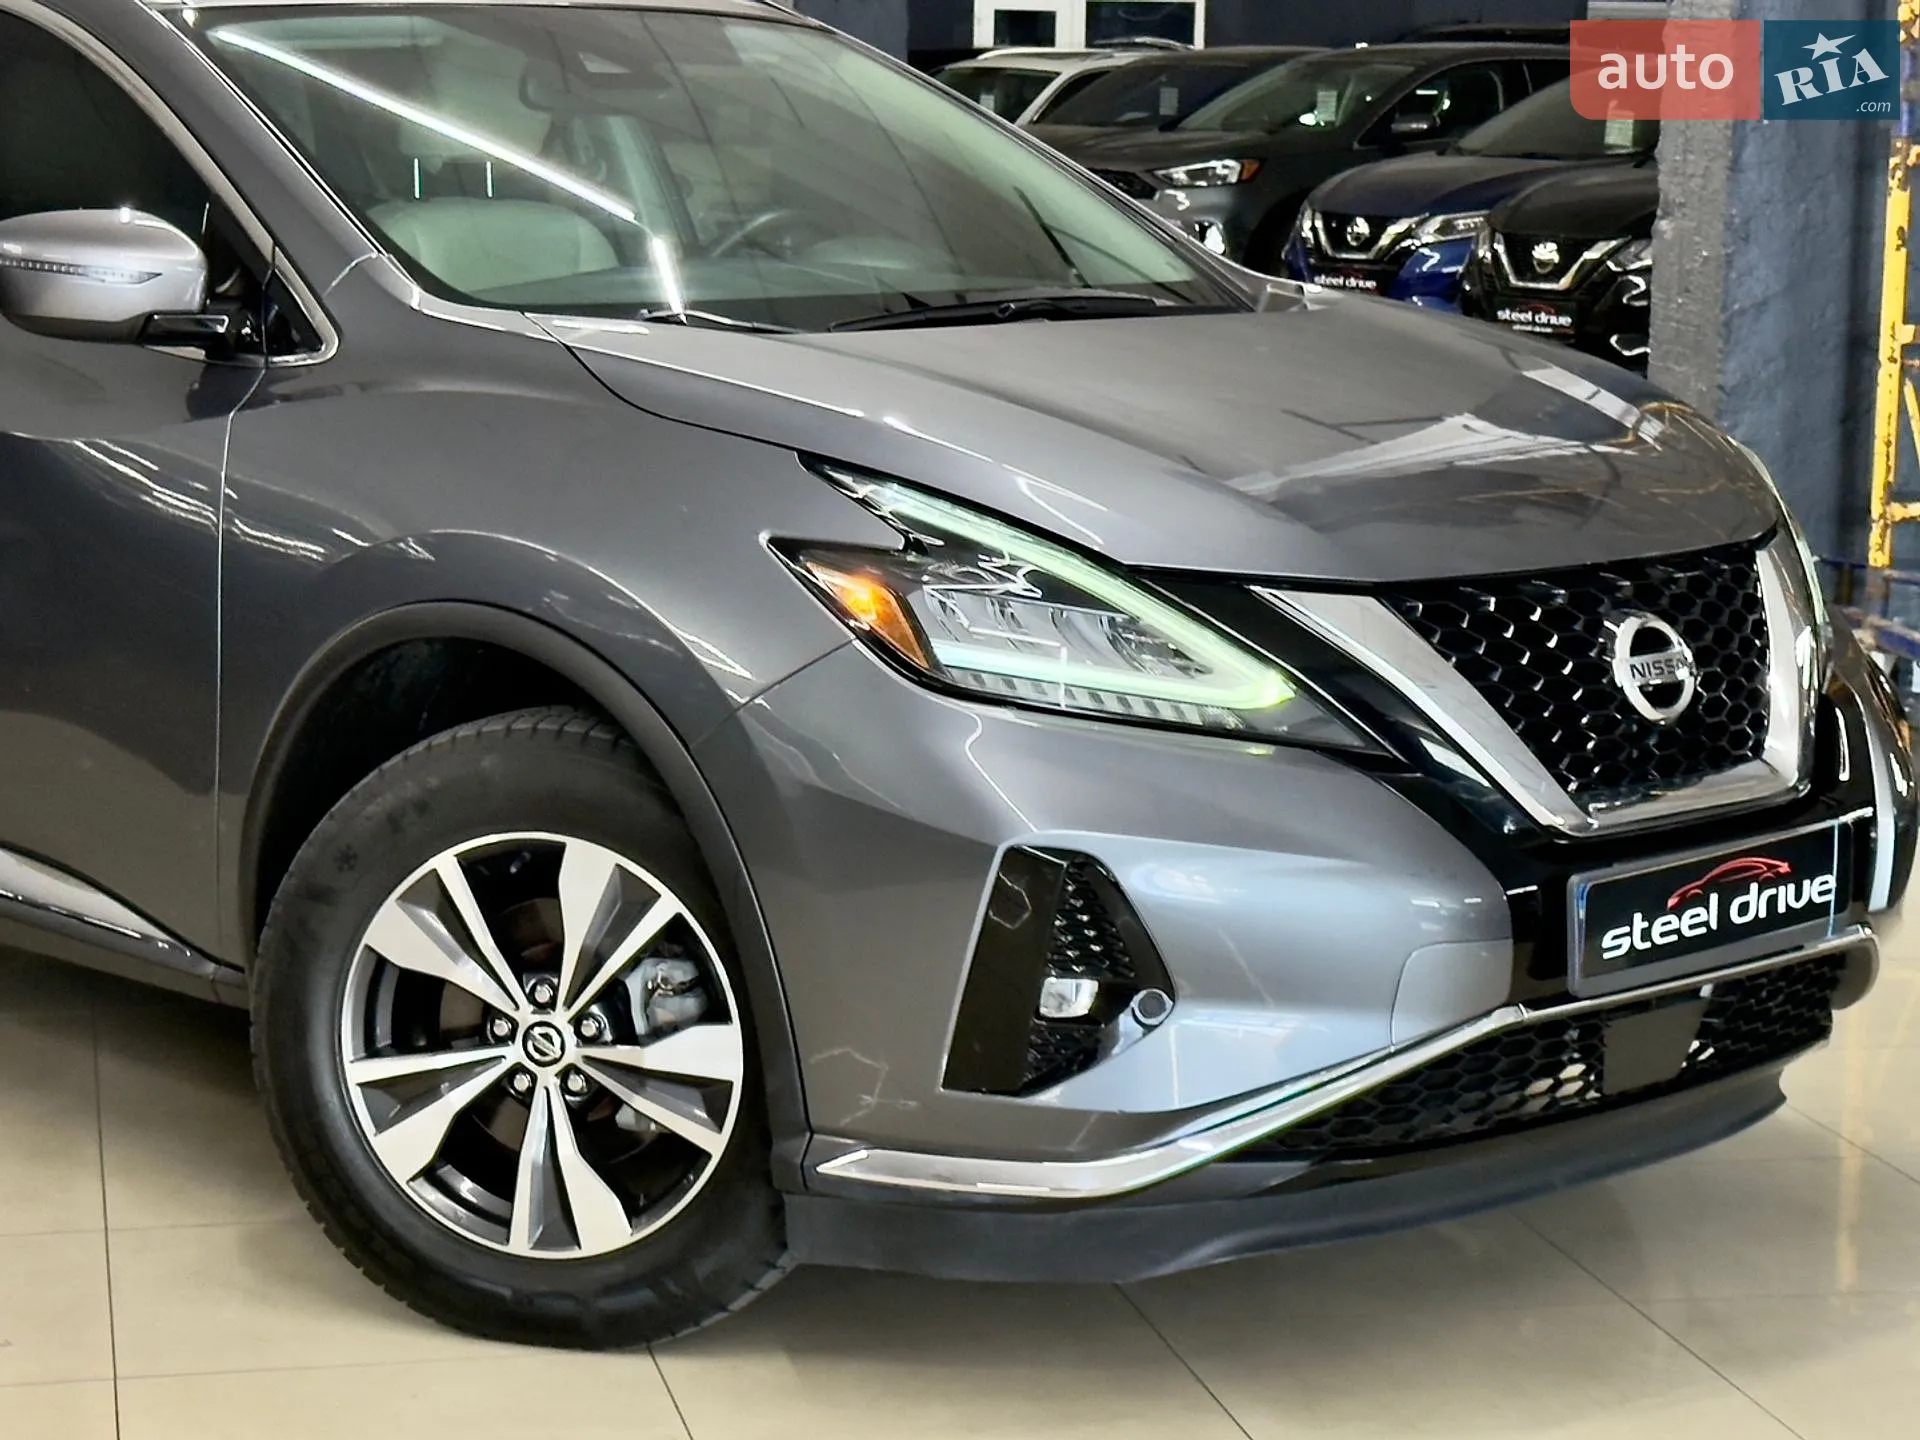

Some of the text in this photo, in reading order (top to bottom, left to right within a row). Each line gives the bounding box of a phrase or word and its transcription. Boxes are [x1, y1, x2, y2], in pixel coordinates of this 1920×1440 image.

[1496, 307, 1573, 327] steel drive
[1601, 874, 1837, 960] steel drive
